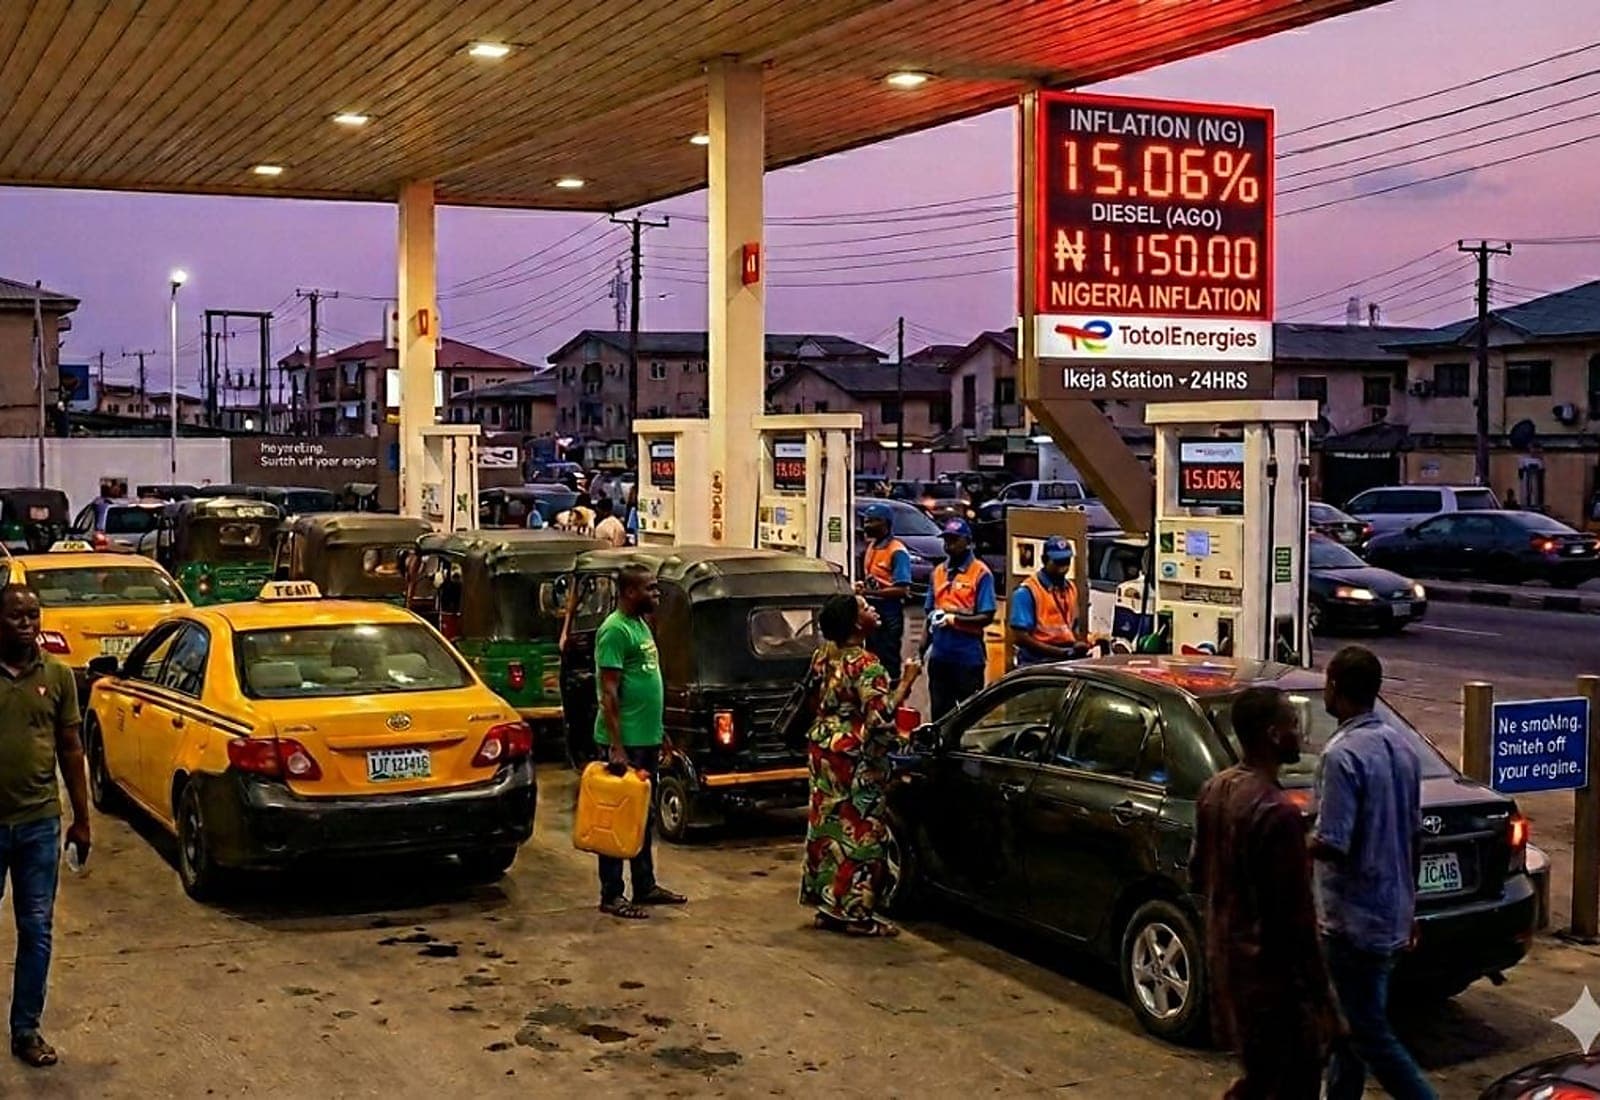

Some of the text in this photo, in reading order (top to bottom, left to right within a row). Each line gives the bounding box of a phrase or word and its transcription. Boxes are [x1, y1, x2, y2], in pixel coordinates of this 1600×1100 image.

[1069, 109, 1245, 148] INFLATION (NG)
[1064, 140, 1259, 203] 15.06%
[1091, 203, 1222, 230] DIESEL (AGO)
[1051, 282, 1261, 311] NIGERIA INFLATION
[1063, 368, 1106, 391] Ikeja
[1111, 369, 1174, 389] Station
[1190, 370, 1248, 390] 24HRS
[1184, 469, 1242, 489] 15.06%
[1547, 735, 1567, 753] off
[1498, 764, 1530, 784] your
